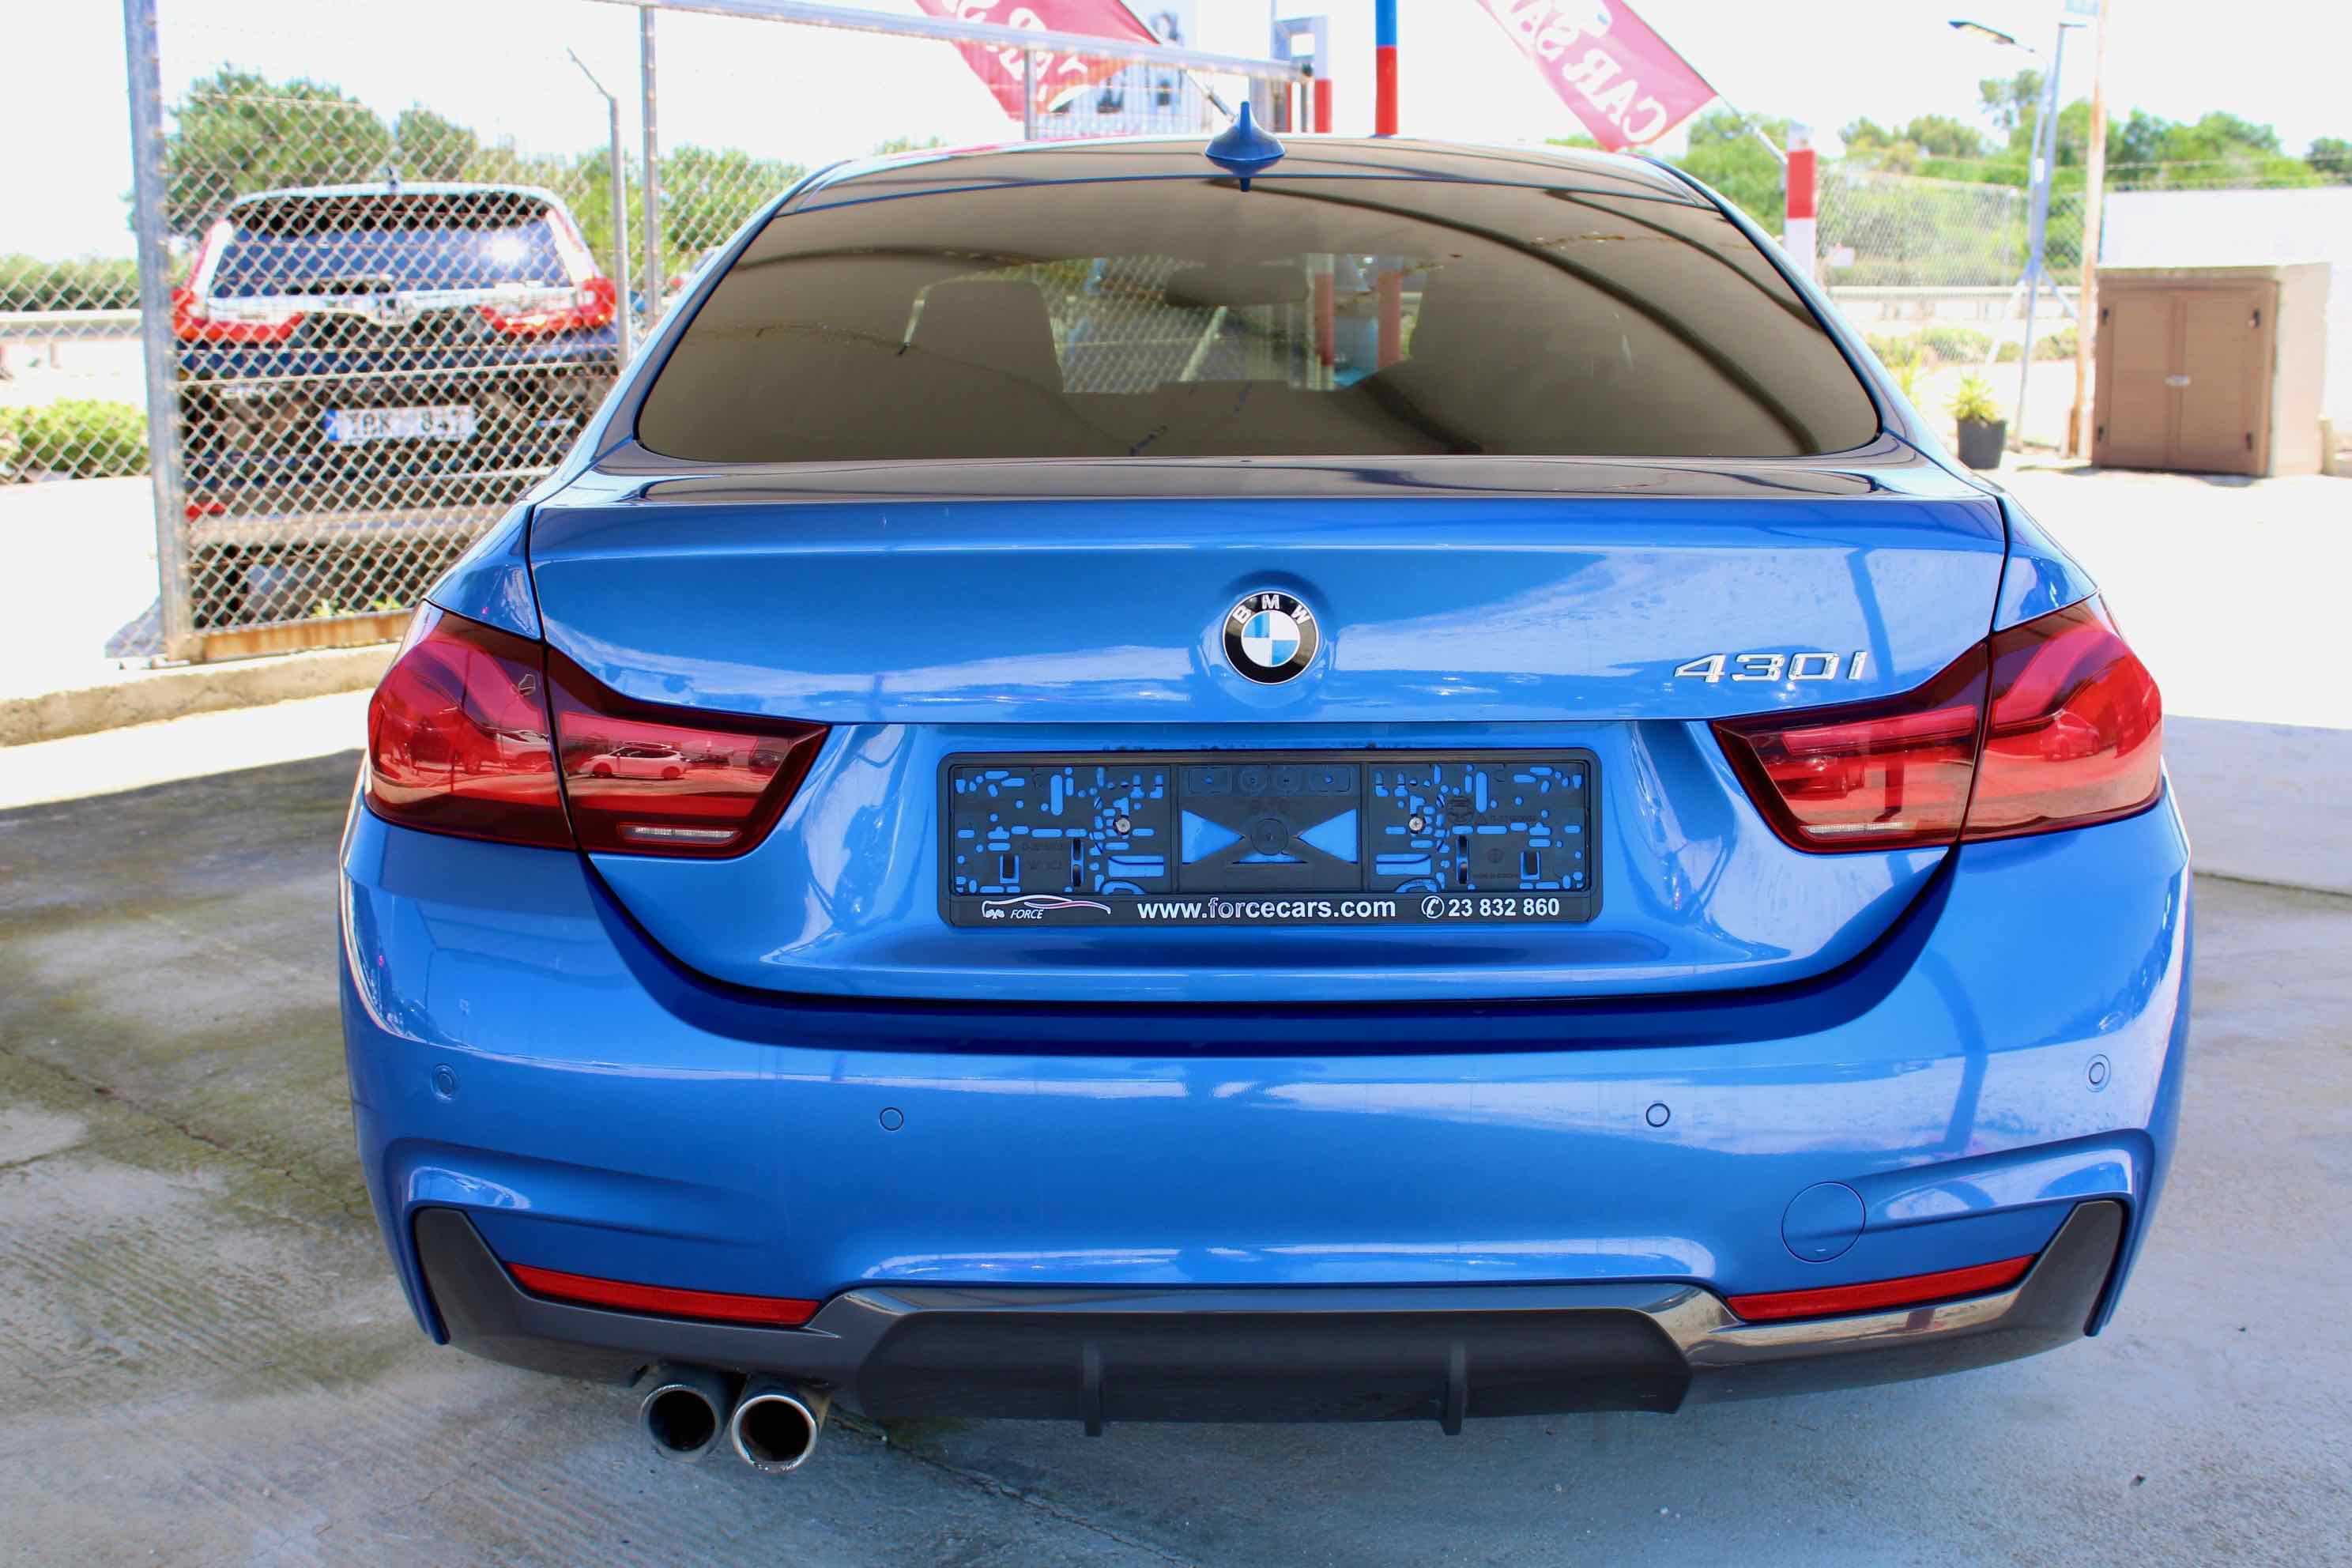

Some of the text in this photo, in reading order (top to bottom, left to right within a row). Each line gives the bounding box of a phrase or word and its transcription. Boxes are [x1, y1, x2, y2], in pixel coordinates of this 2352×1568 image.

[1231, 594, 1311, 624] BMW
[1009, 908, 1044, 920] FORCE
[1136, 897, 1396, 919] www.forcecars.com
[1447, 897, 1560, 918] 23 832 860
